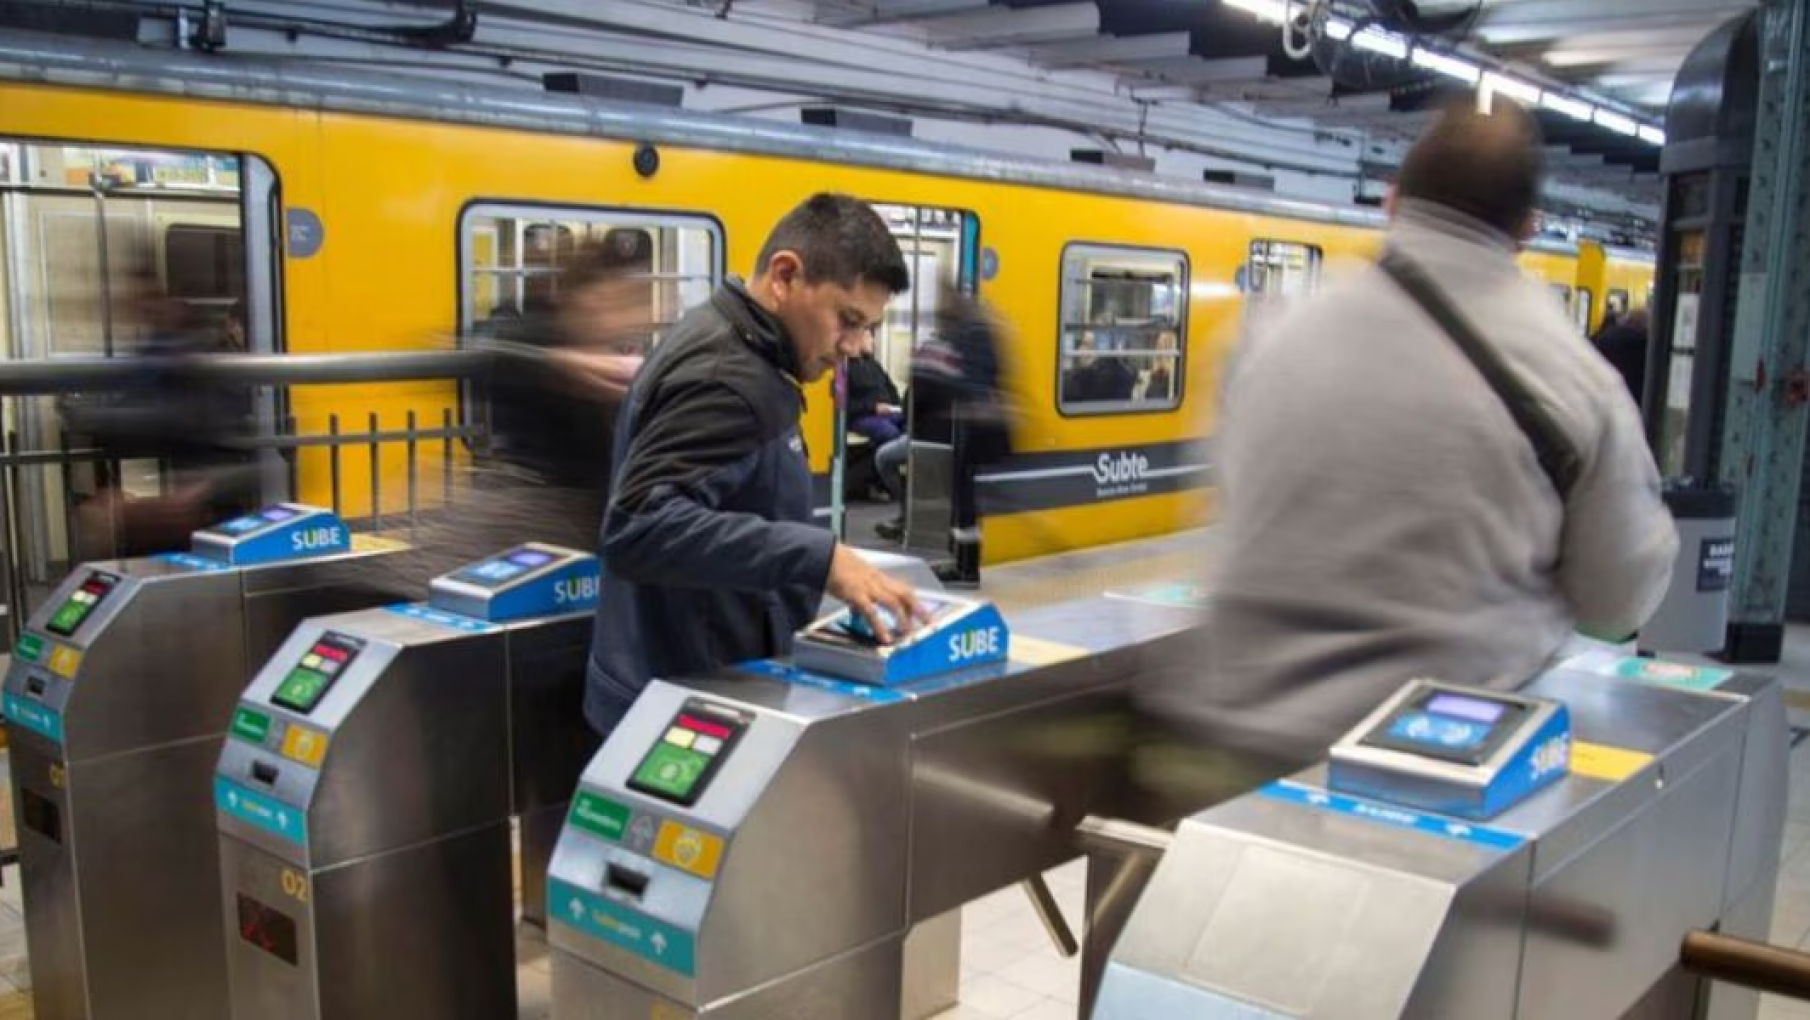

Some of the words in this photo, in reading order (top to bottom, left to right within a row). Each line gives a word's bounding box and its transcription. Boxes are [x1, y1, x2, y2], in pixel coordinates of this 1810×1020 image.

[1097, 450, 1148, 484] Subte
[291, 526, 341, 550] SUBE
[949, 626, 1000, 661] SUBE
[281, 868, 309, 904] 02
